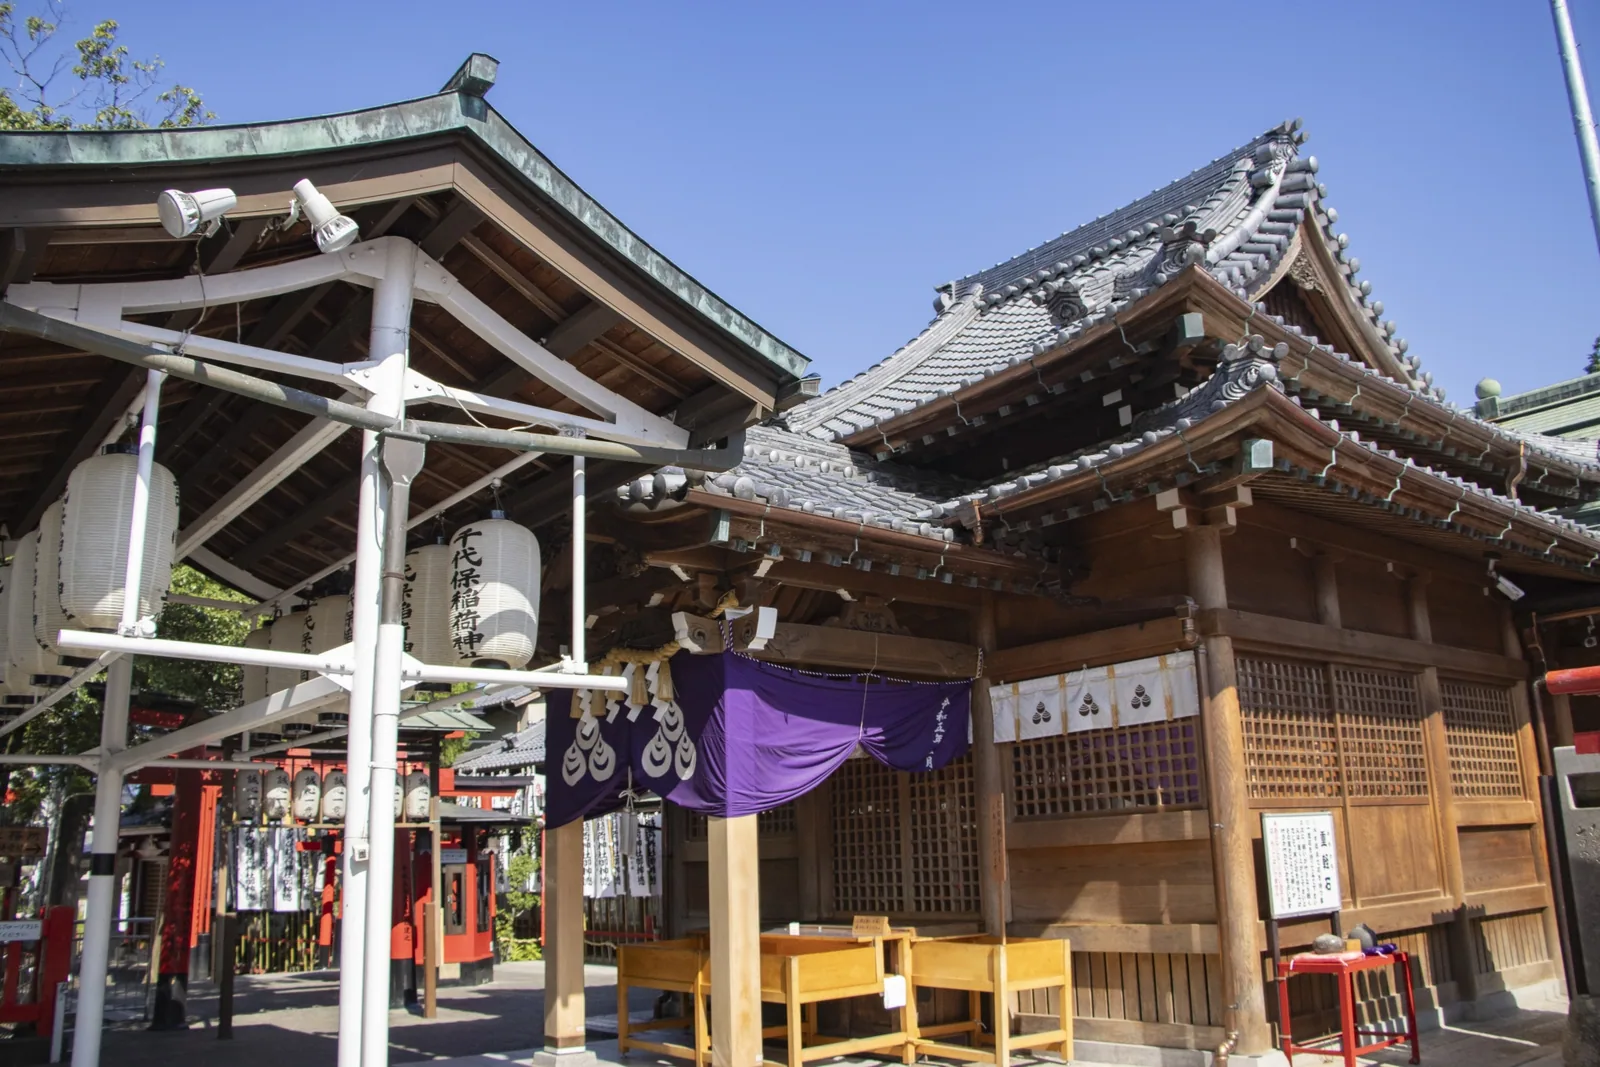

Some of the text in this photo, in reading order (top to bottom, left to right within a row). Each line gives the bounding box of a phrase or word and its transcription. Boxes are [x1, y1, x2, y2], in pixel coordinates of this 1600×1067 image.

[452, 528, 485, 659] 千代保稲荷神社
